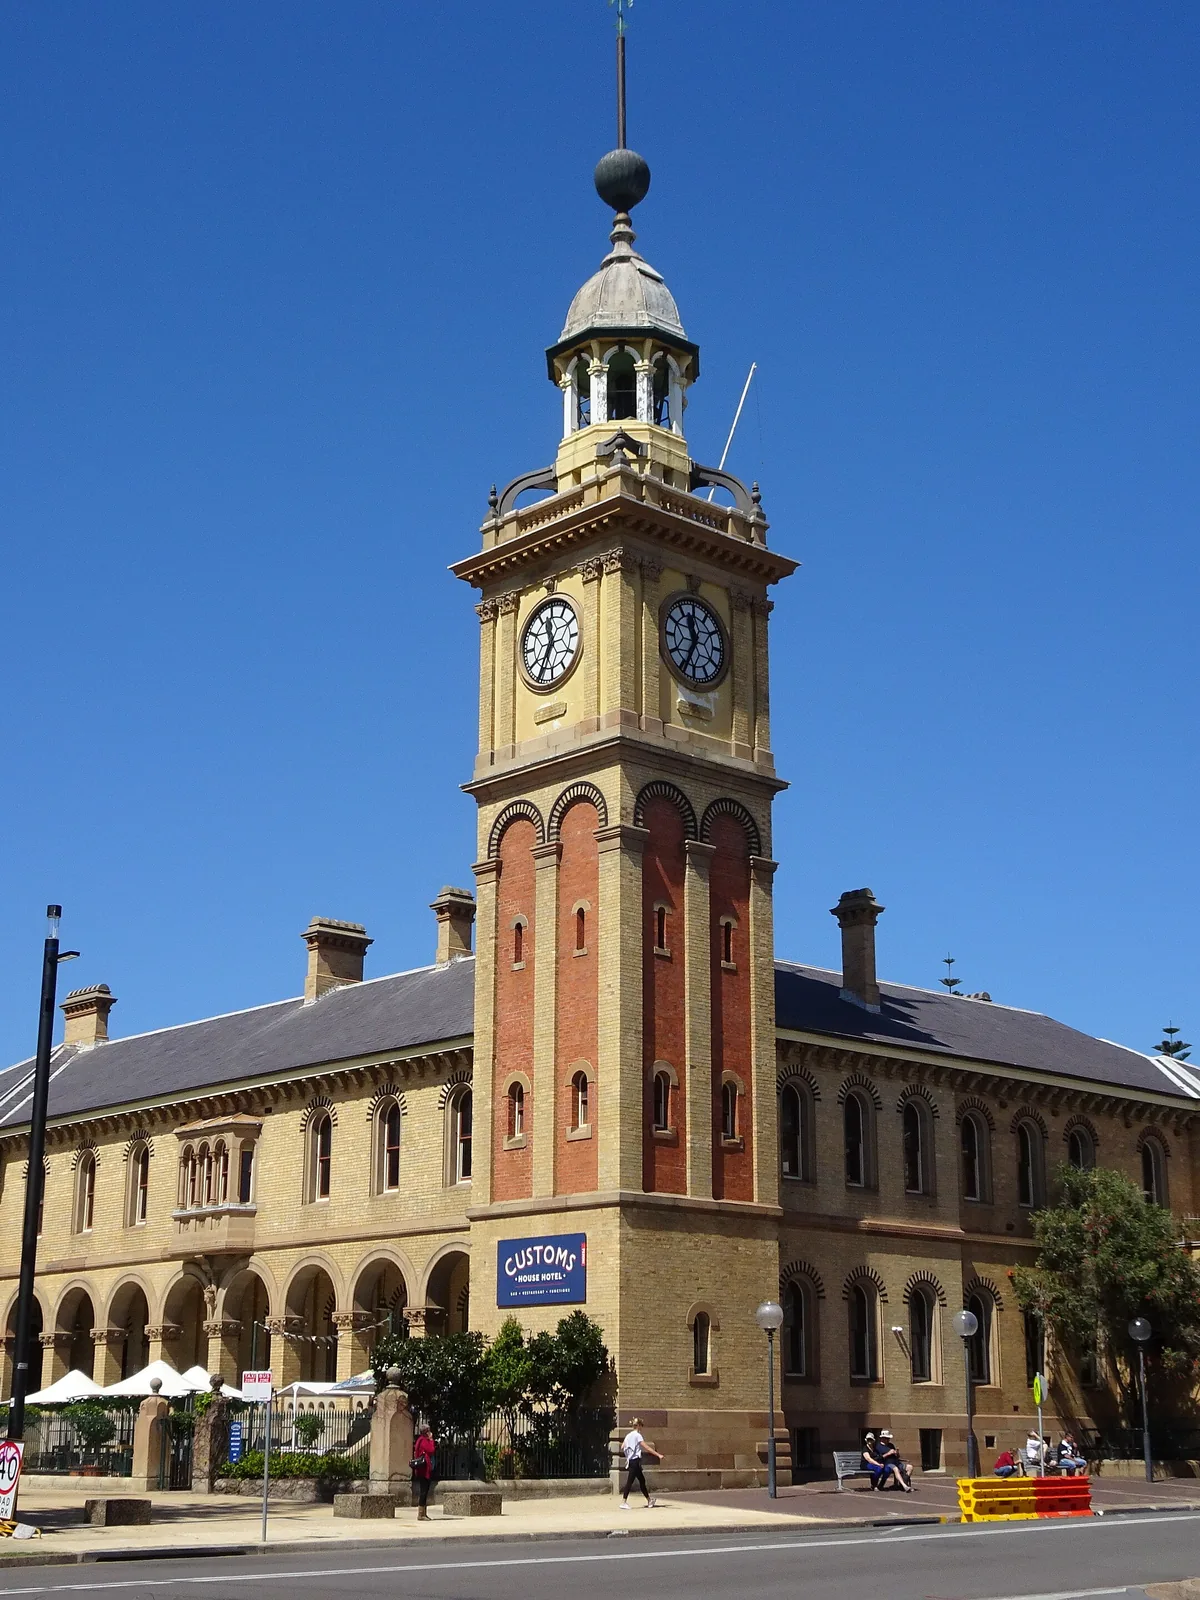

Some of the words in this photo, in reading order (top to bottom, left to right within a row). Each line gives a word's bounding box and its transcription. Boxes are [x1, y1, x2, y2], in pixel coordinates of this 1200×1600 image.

[505, 1245, 576, 1276] CUSTOMS
[518, 1274, 540, 1283] HOUSE
[541, 1272, 562, 1281] HOTEL
